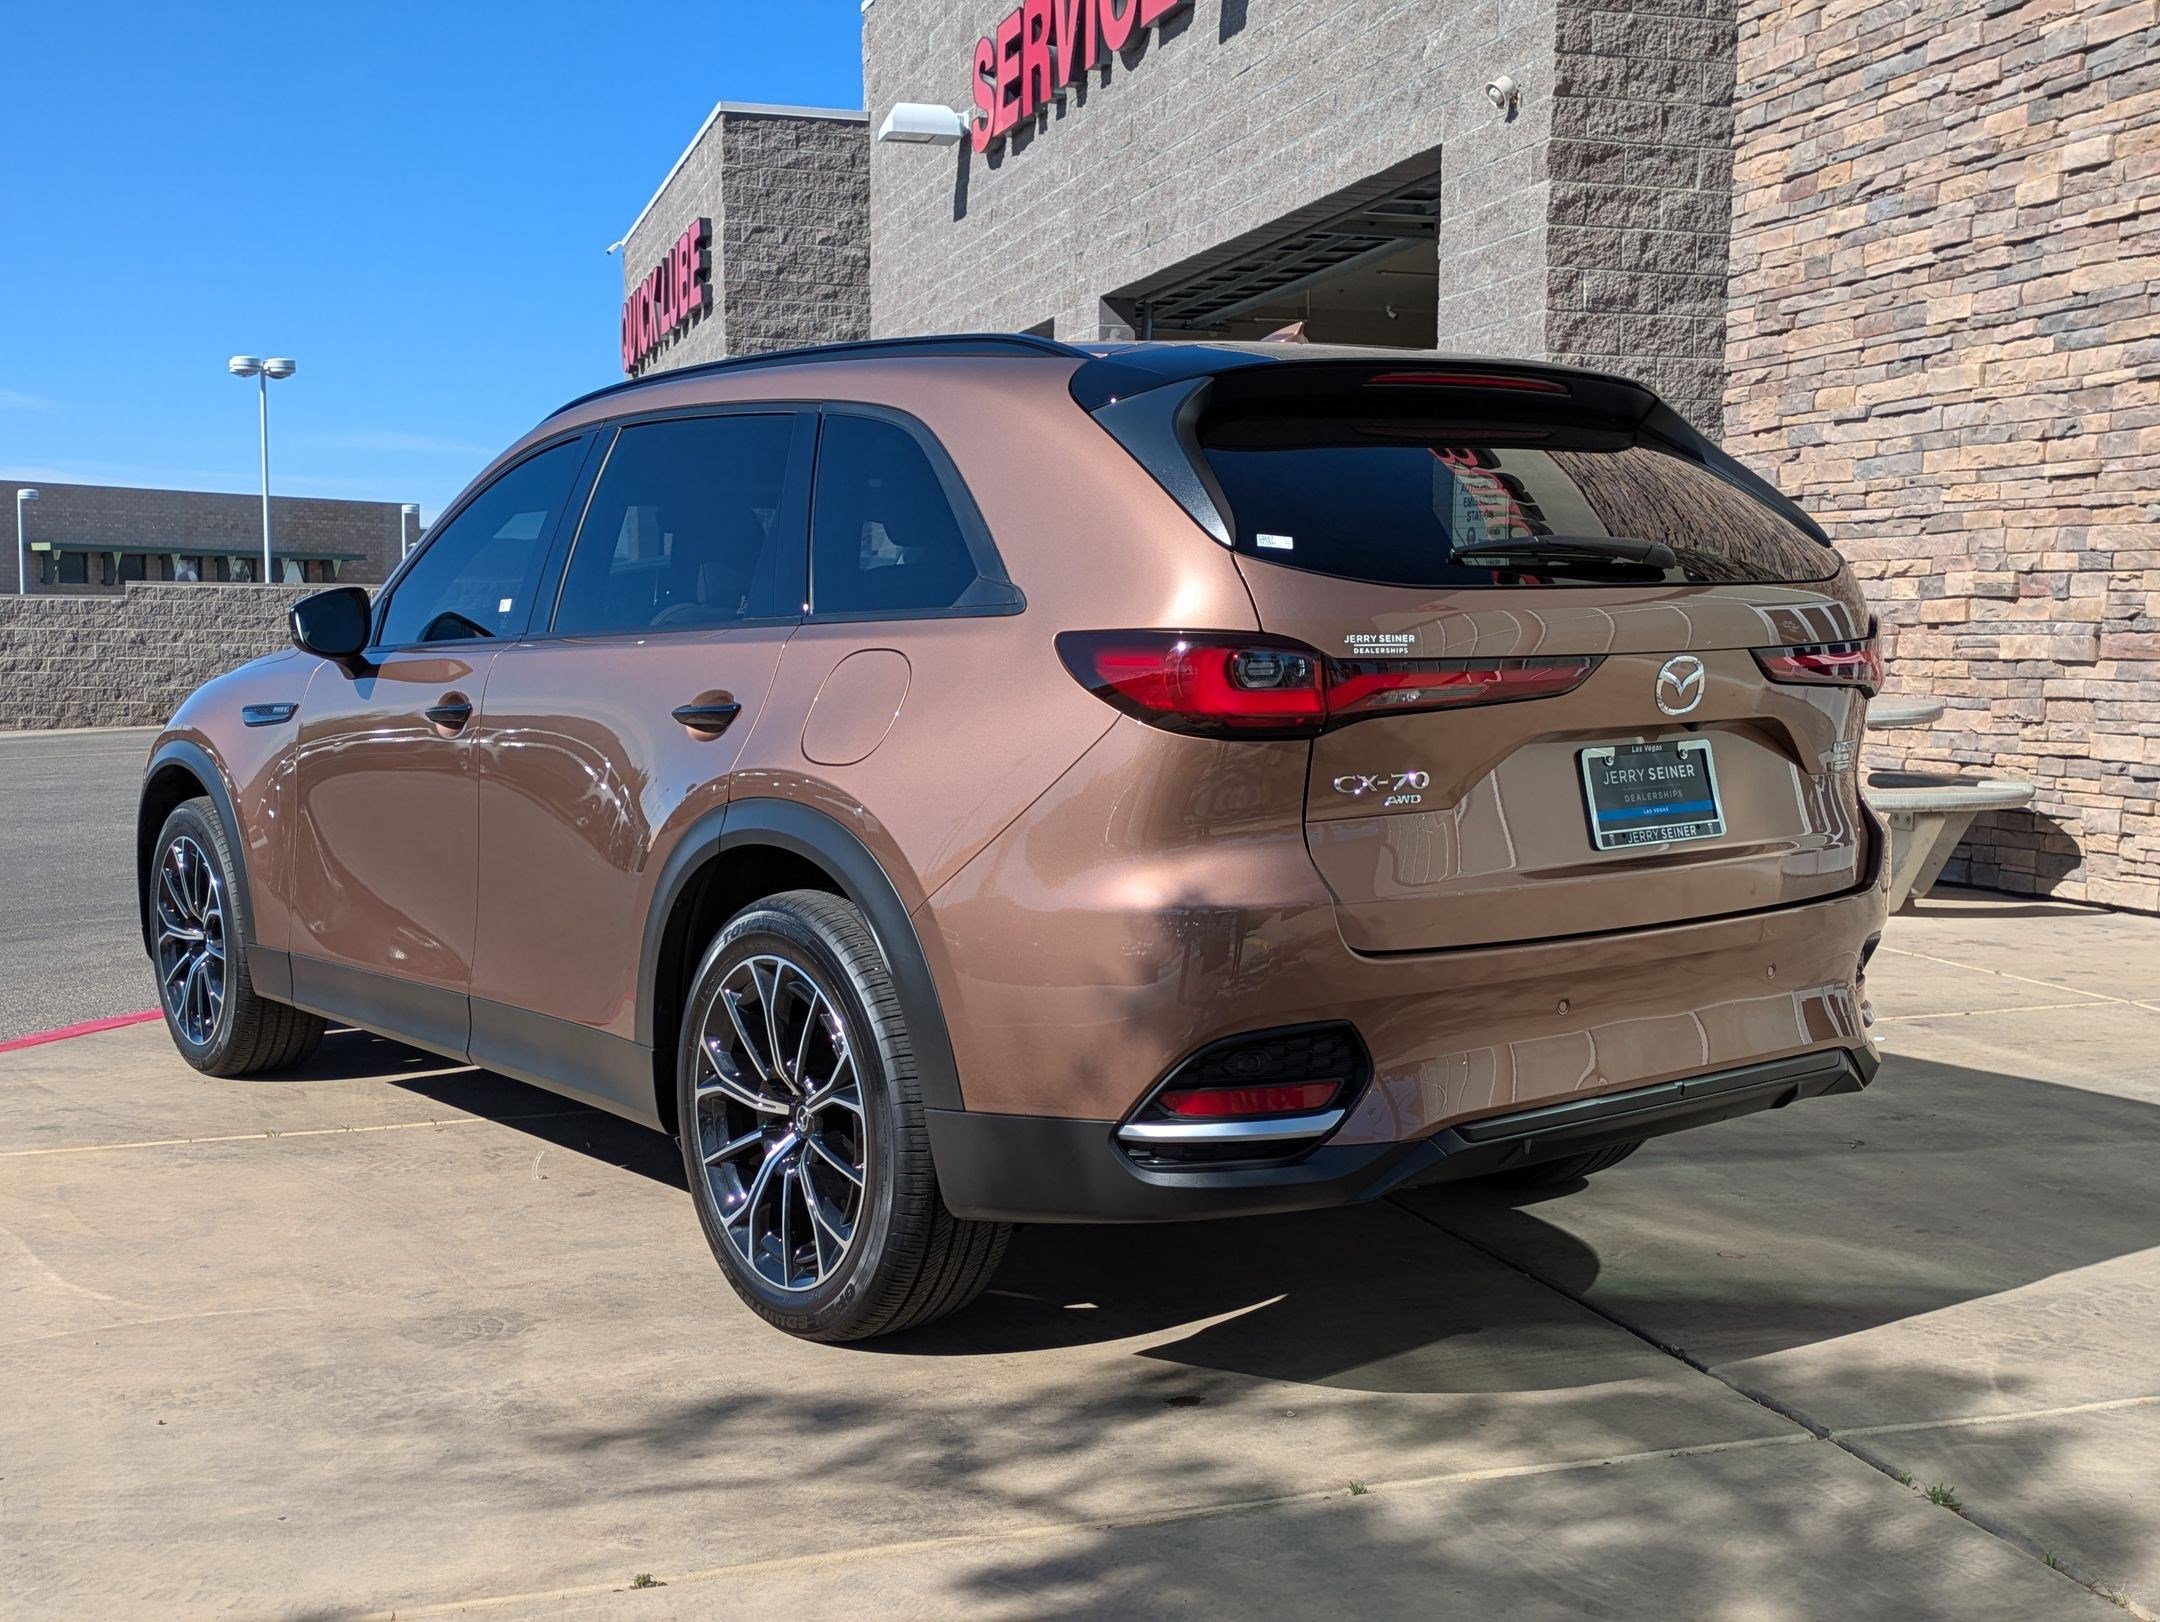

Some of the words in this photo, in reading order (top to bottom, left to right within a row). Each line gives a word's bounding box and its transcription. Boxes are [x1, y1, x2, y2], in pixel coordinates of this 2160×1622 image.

[971, 0, 1180, 153] SERVI
[621, 266, 662, 373] QUICK
[661, 217, 703, 336] LUBE
[1343, 634, 1377, 643] JERRY
[1379, 634, 1415, 643] SEINER
[1645, 744, 1662, 752] Vegas
[1333, 771, 1430, 794] CX-70
[1603, 769, 1644, 785] JERRY
[1648, 765, 1695, 780] SEINER
[1384, 794, 1422, 807] AWD
[1624, 789, 1683, 803] DEALERSHIPS
[1653, 806, 1669, 814] VEGAS
[1627, 830, 1661, 844] JERRY
[1661, 825, 1697, 839] SEINER
